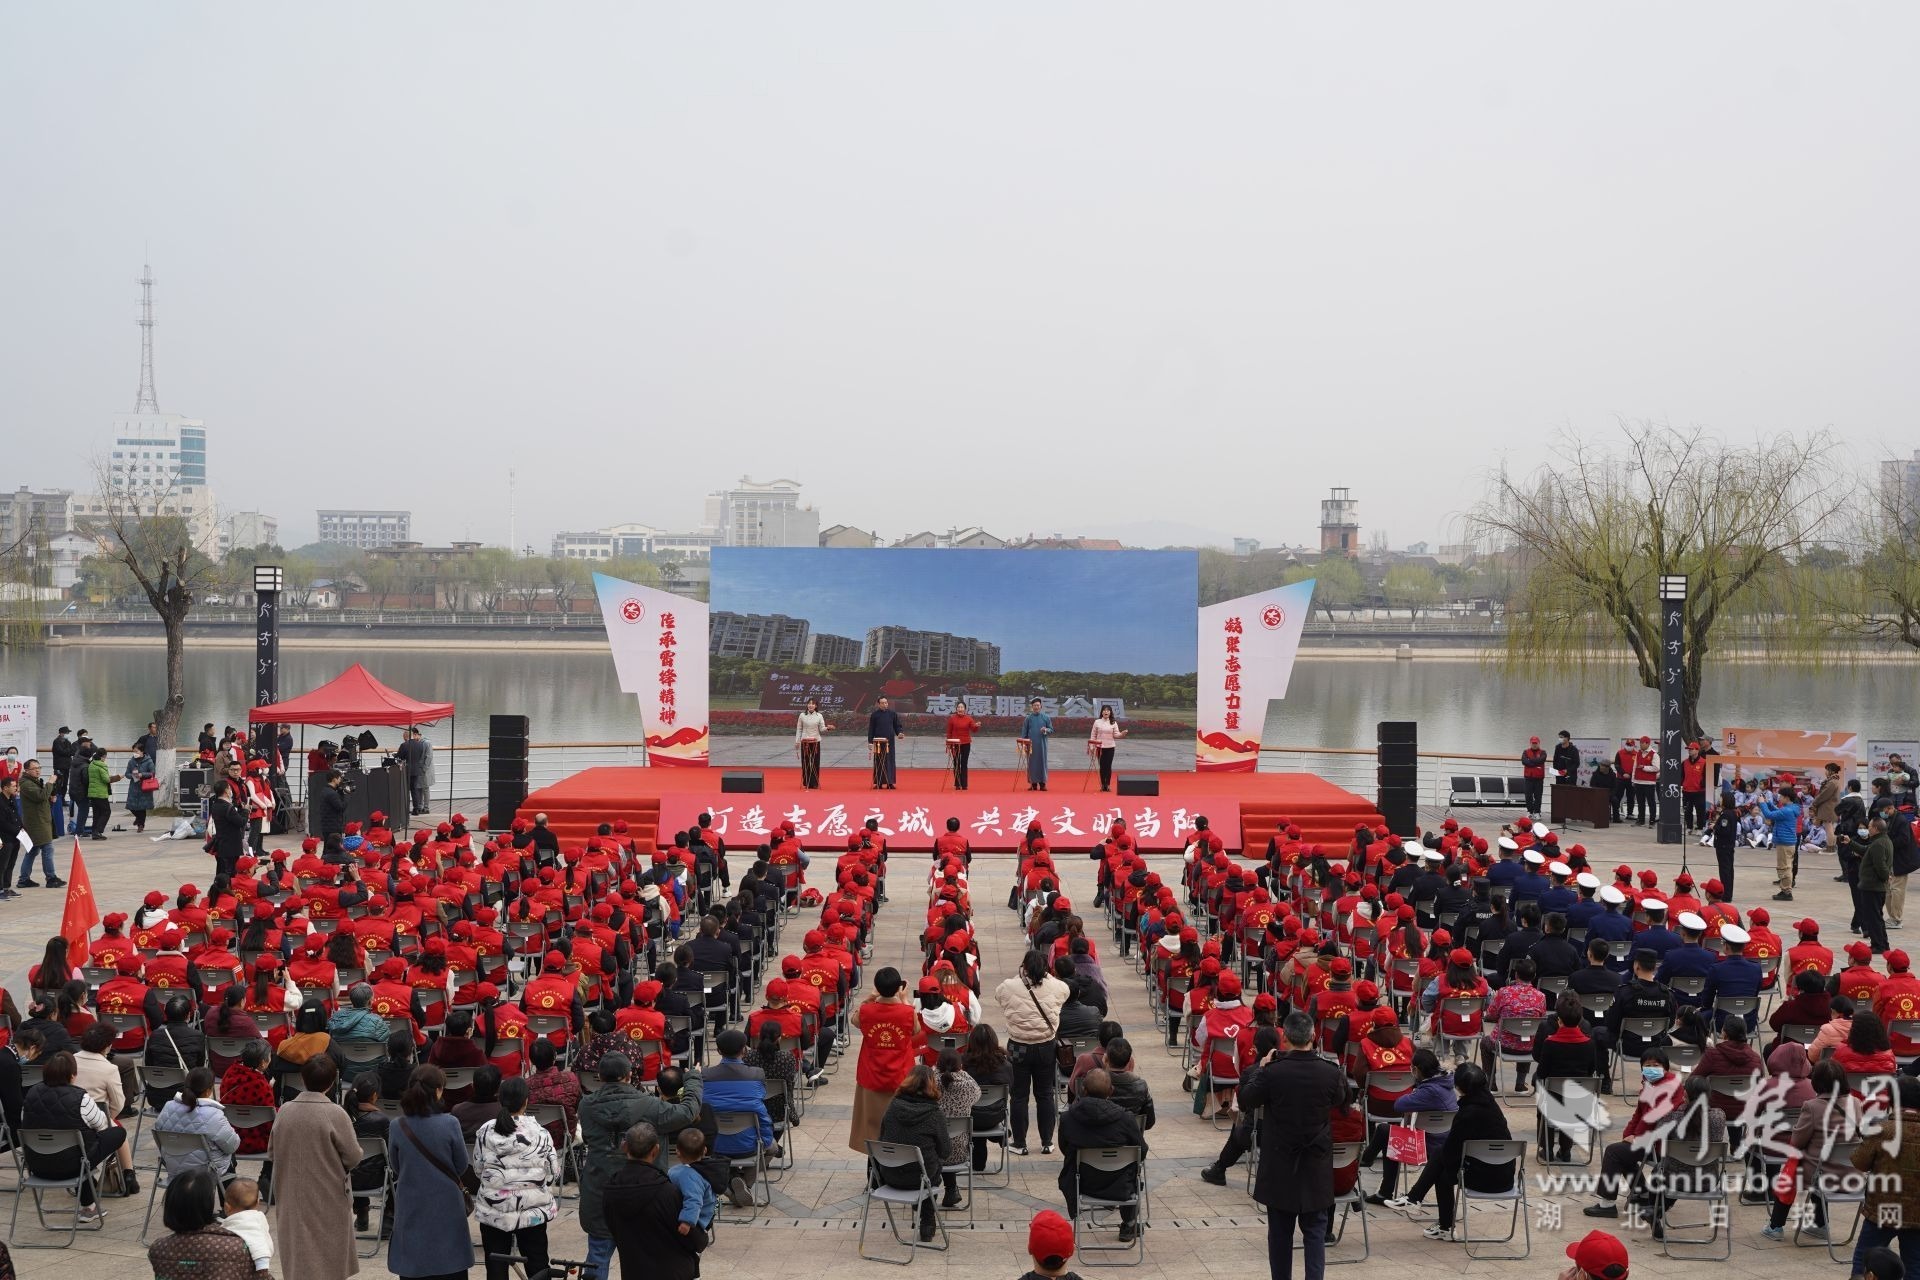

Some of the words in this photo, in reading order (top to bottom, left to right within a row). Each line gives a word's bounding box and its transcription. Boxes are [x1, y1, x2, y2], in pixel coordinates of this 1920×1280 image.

[658, 612, 677, 725] 传承雷锋精神
[1224, 617, 1243, 730] 凝聚志愿力量
[926, 693, 1125, 719] 志愿服务公园
[706, 804, 934, 837] 打造志愿之城
[970, 806, 1200, 838] 共建文明当阳
